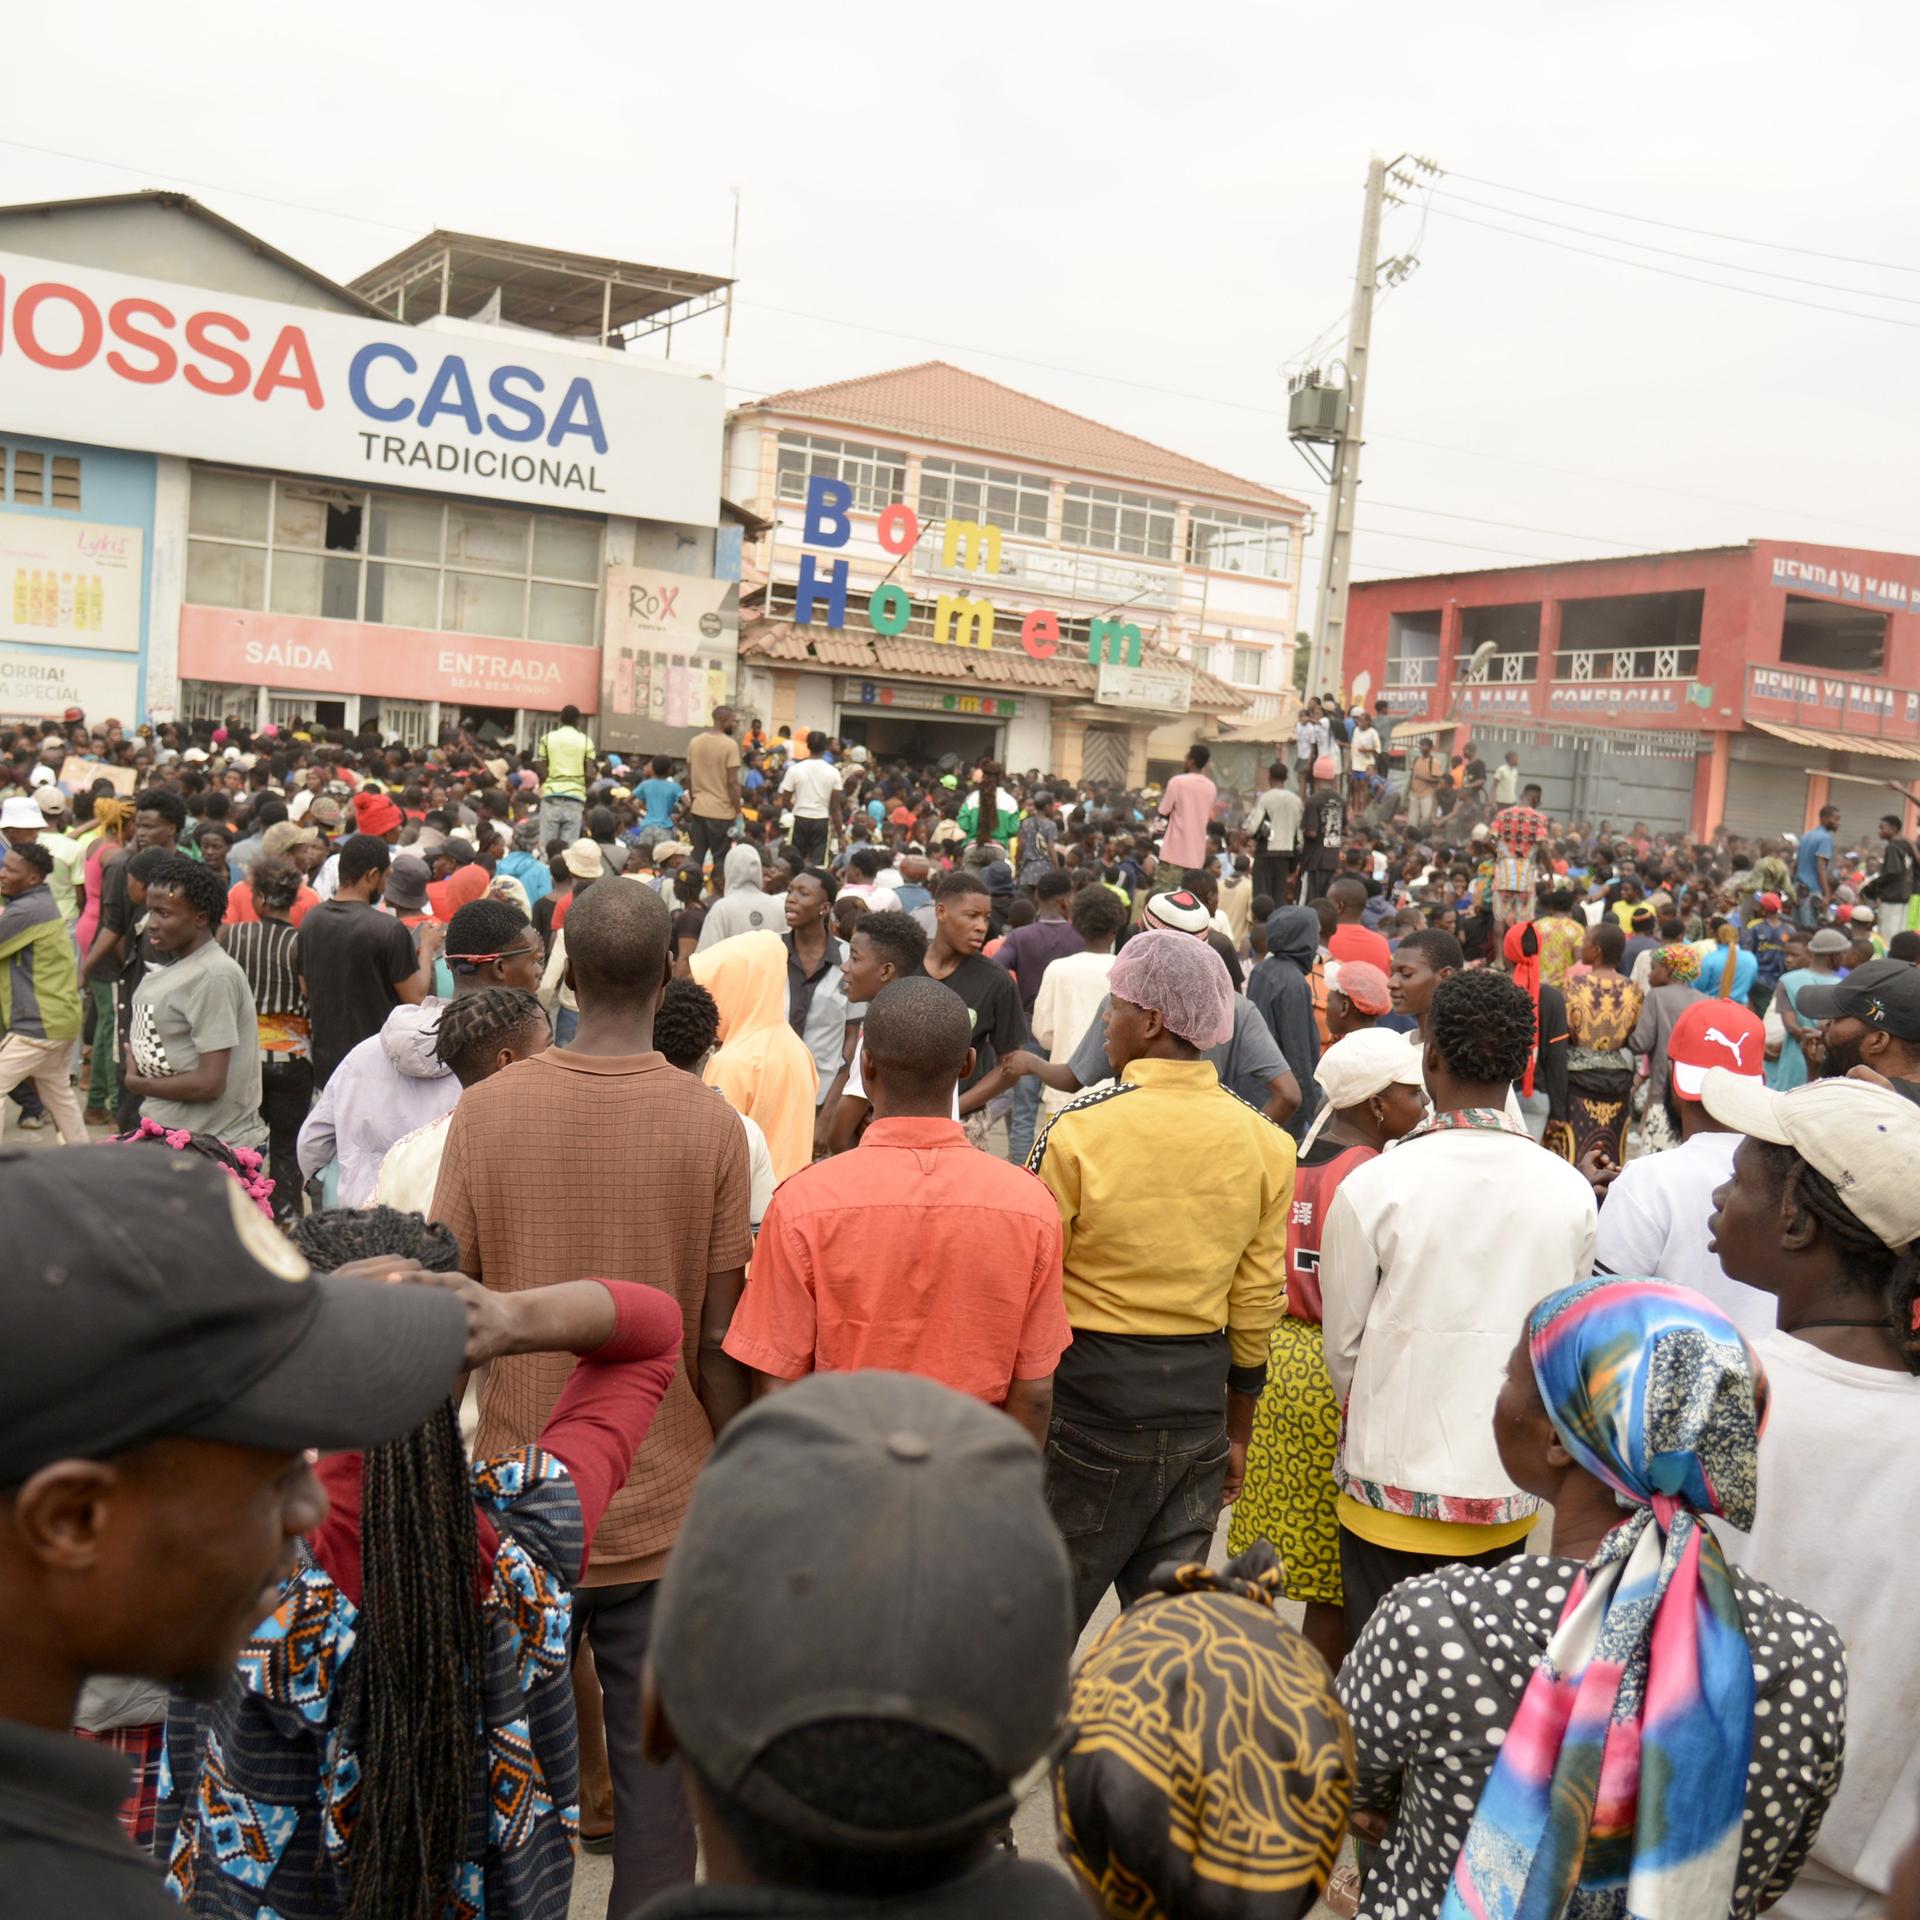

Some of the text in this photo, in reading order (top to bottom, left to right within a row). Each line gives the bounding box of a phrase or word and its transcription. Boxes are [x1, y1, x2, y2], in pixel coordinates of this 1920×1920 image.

[0, 273, 609, 455] OSSA CASA
[358, 431, 607, 493] TRADICIONAL
[803, 475, 1002, 575] Bom
[795, 554, 1142, 668] Homem
[245, 639, 562, 683] SAÍDA ENTRADA
[15, 682, 82, 703] SPECIAL
[1550, 688, 1679, 712] COMERCIAL
